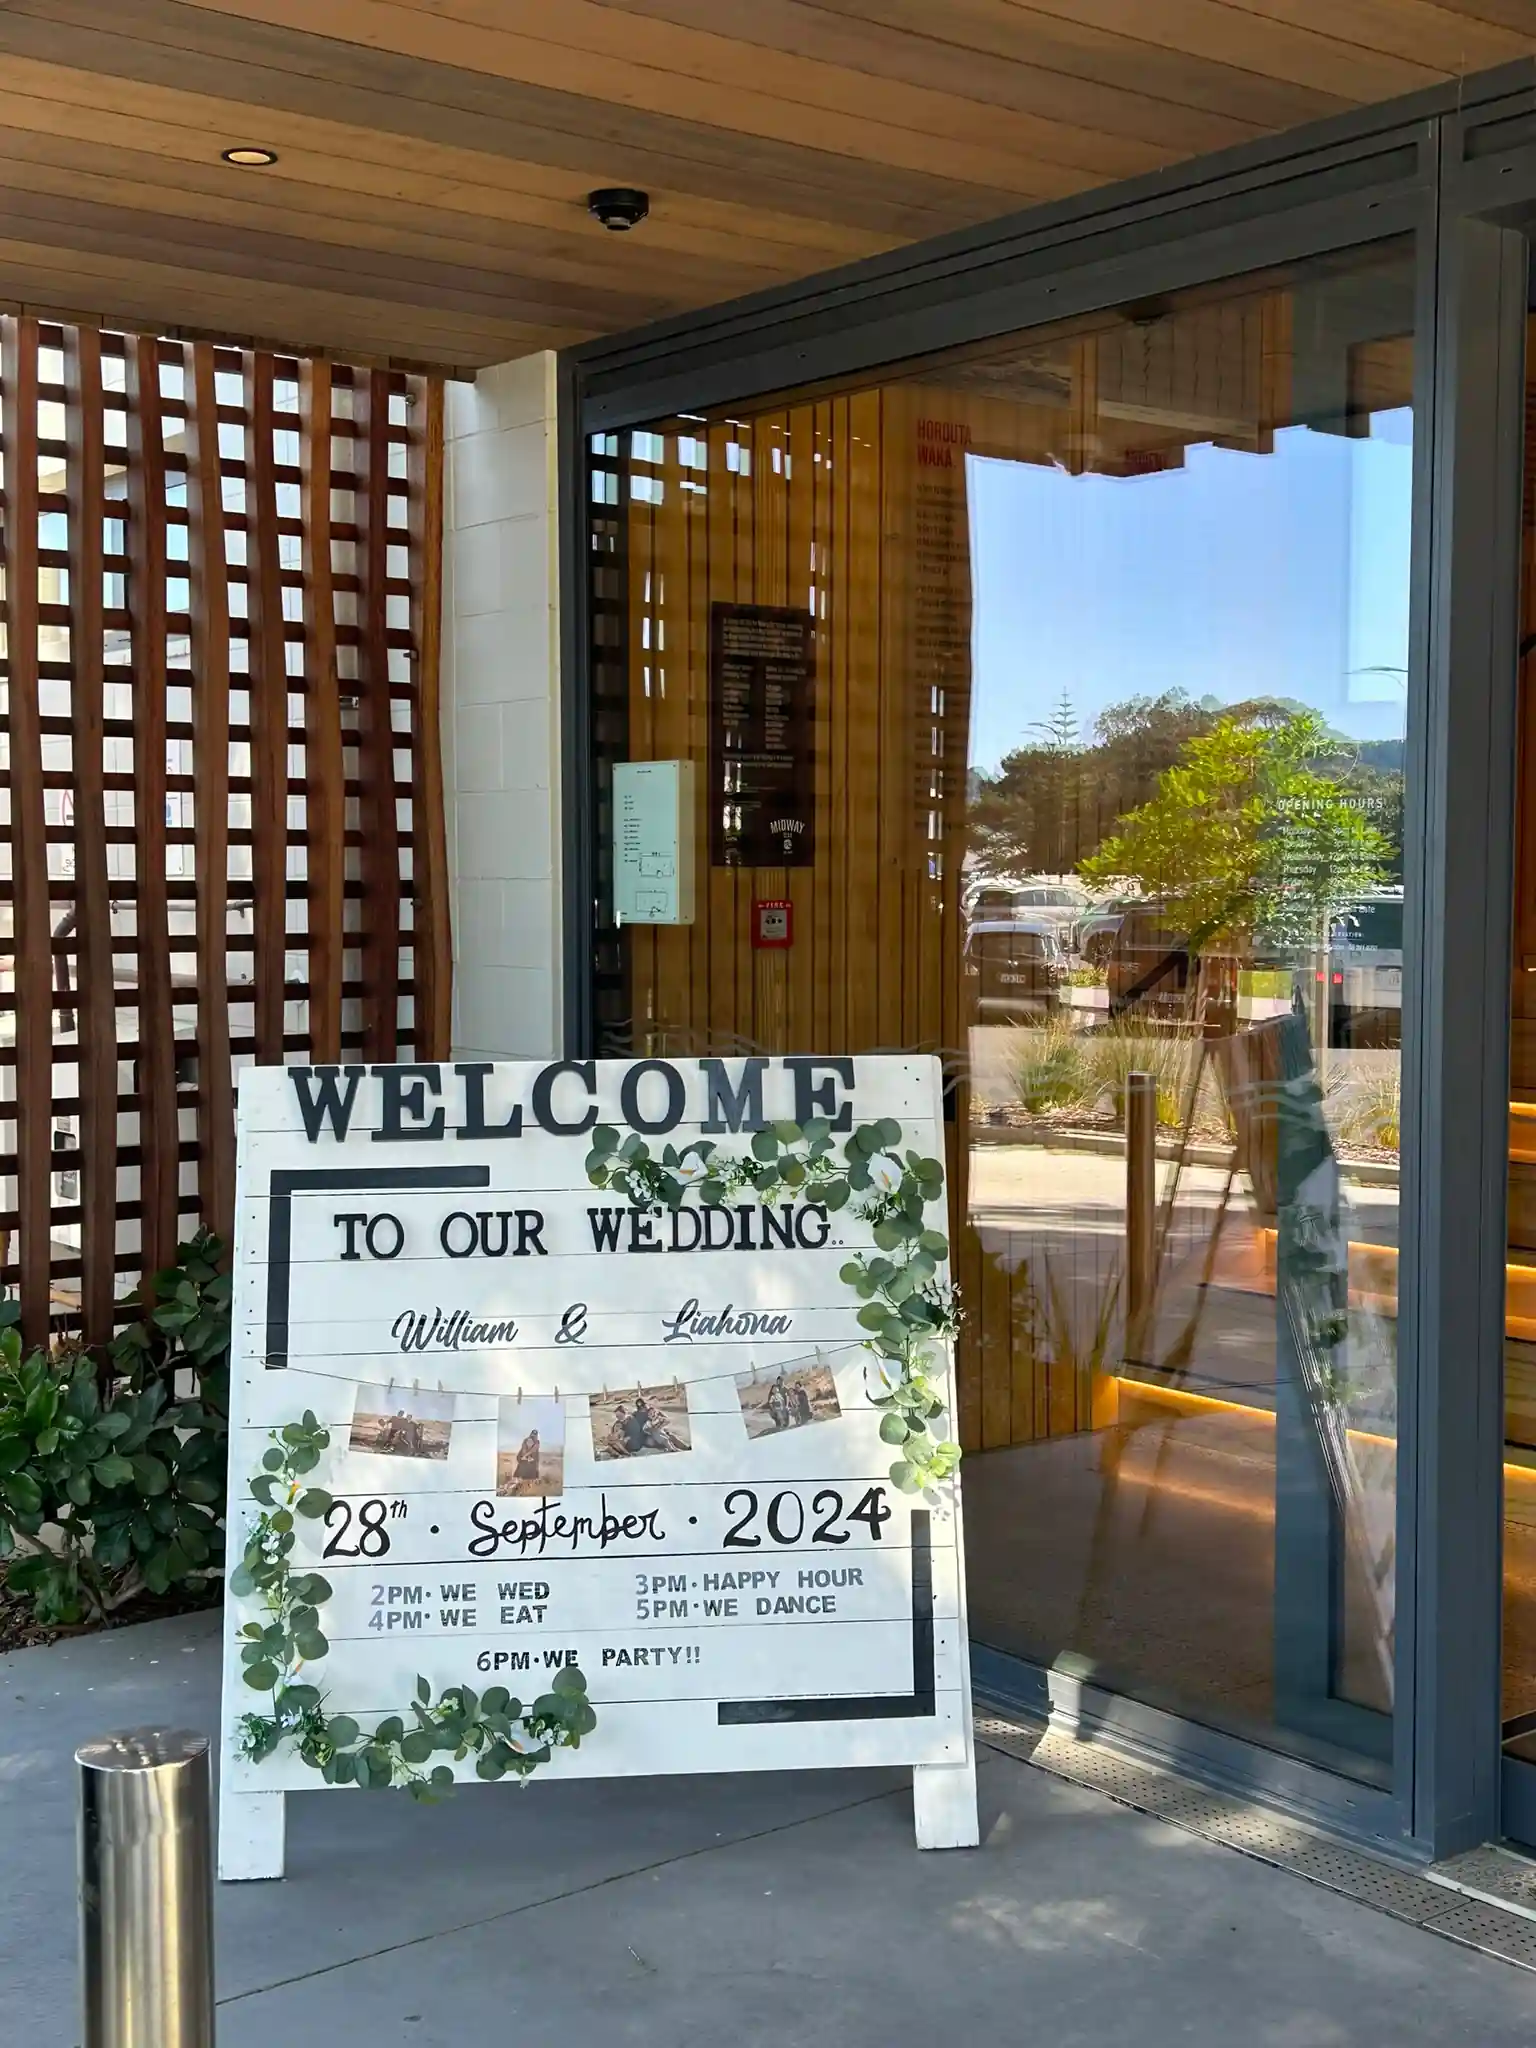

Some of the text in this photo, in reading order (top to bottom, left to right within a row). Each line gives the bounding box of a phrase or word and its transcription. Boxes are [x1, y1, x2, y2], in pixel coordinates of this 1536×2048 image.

[1278, 798, 1383, 811] OPENING HOURS
[770, 819, 805, 834] MIDWAY
[288, 1057, 855, 1143] WELCOME
[334, 1212, 404, 1260] TO
[440, 1210, 548, 1258] OUR
[391, 1298, 793, 1353] William & Liahona
[468, 1493, 666, 1556] September
[723, 1487, 892, 1548] 2024
[798, 1568, 864, 1589] HOUR
[440, 1583, 477, 1602] WE
[498, 1581, 550, 1601] WED
[440, 1608, 477, 1627] WE
[500, 1604, 548, 1625] EAT
[756, 1595, 837, 1616] DANCE
[602, 1646, 701, 1666] PARTY!!
